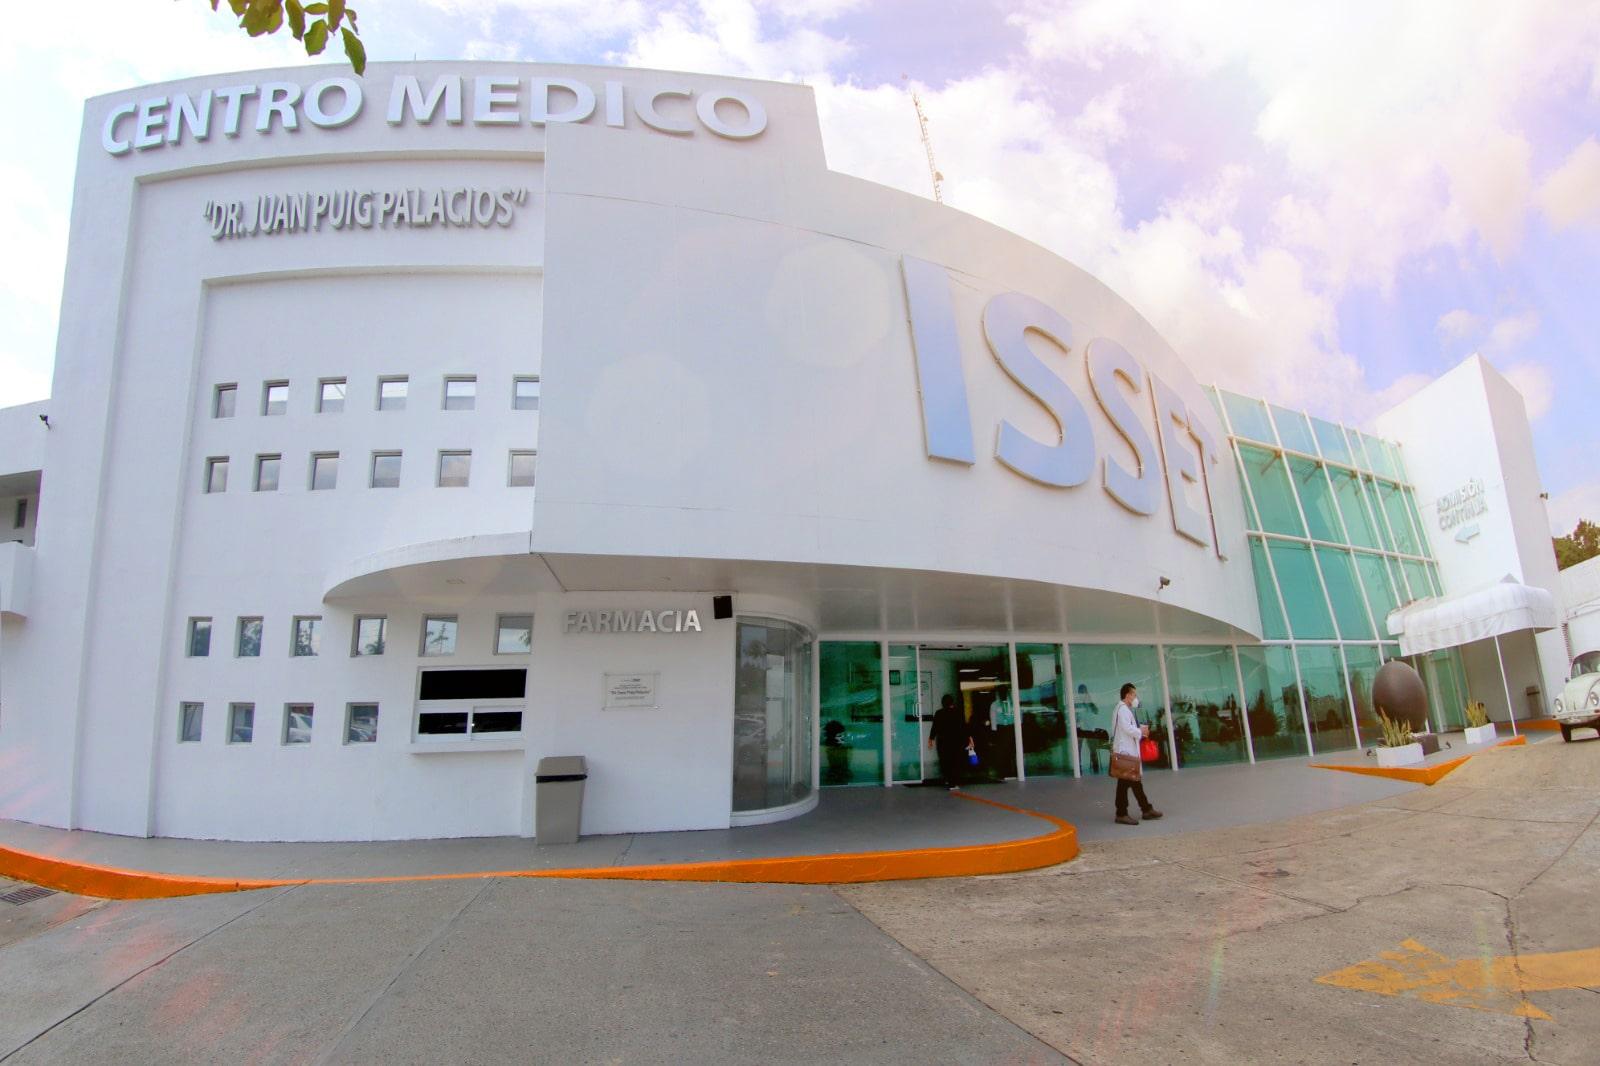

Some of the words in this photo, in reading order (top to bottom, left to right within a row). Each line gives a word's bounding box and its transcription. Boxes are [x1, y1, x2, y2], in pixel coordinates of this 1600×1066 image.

[101, 76, 364, 157] CENTRO
[386, 74, 769, 140] MEDICO
[247, 191, 308, 235] JUAN
[312, 189, 373, 232] PUIG
[563, 608, 702, 634] FARMACIA
